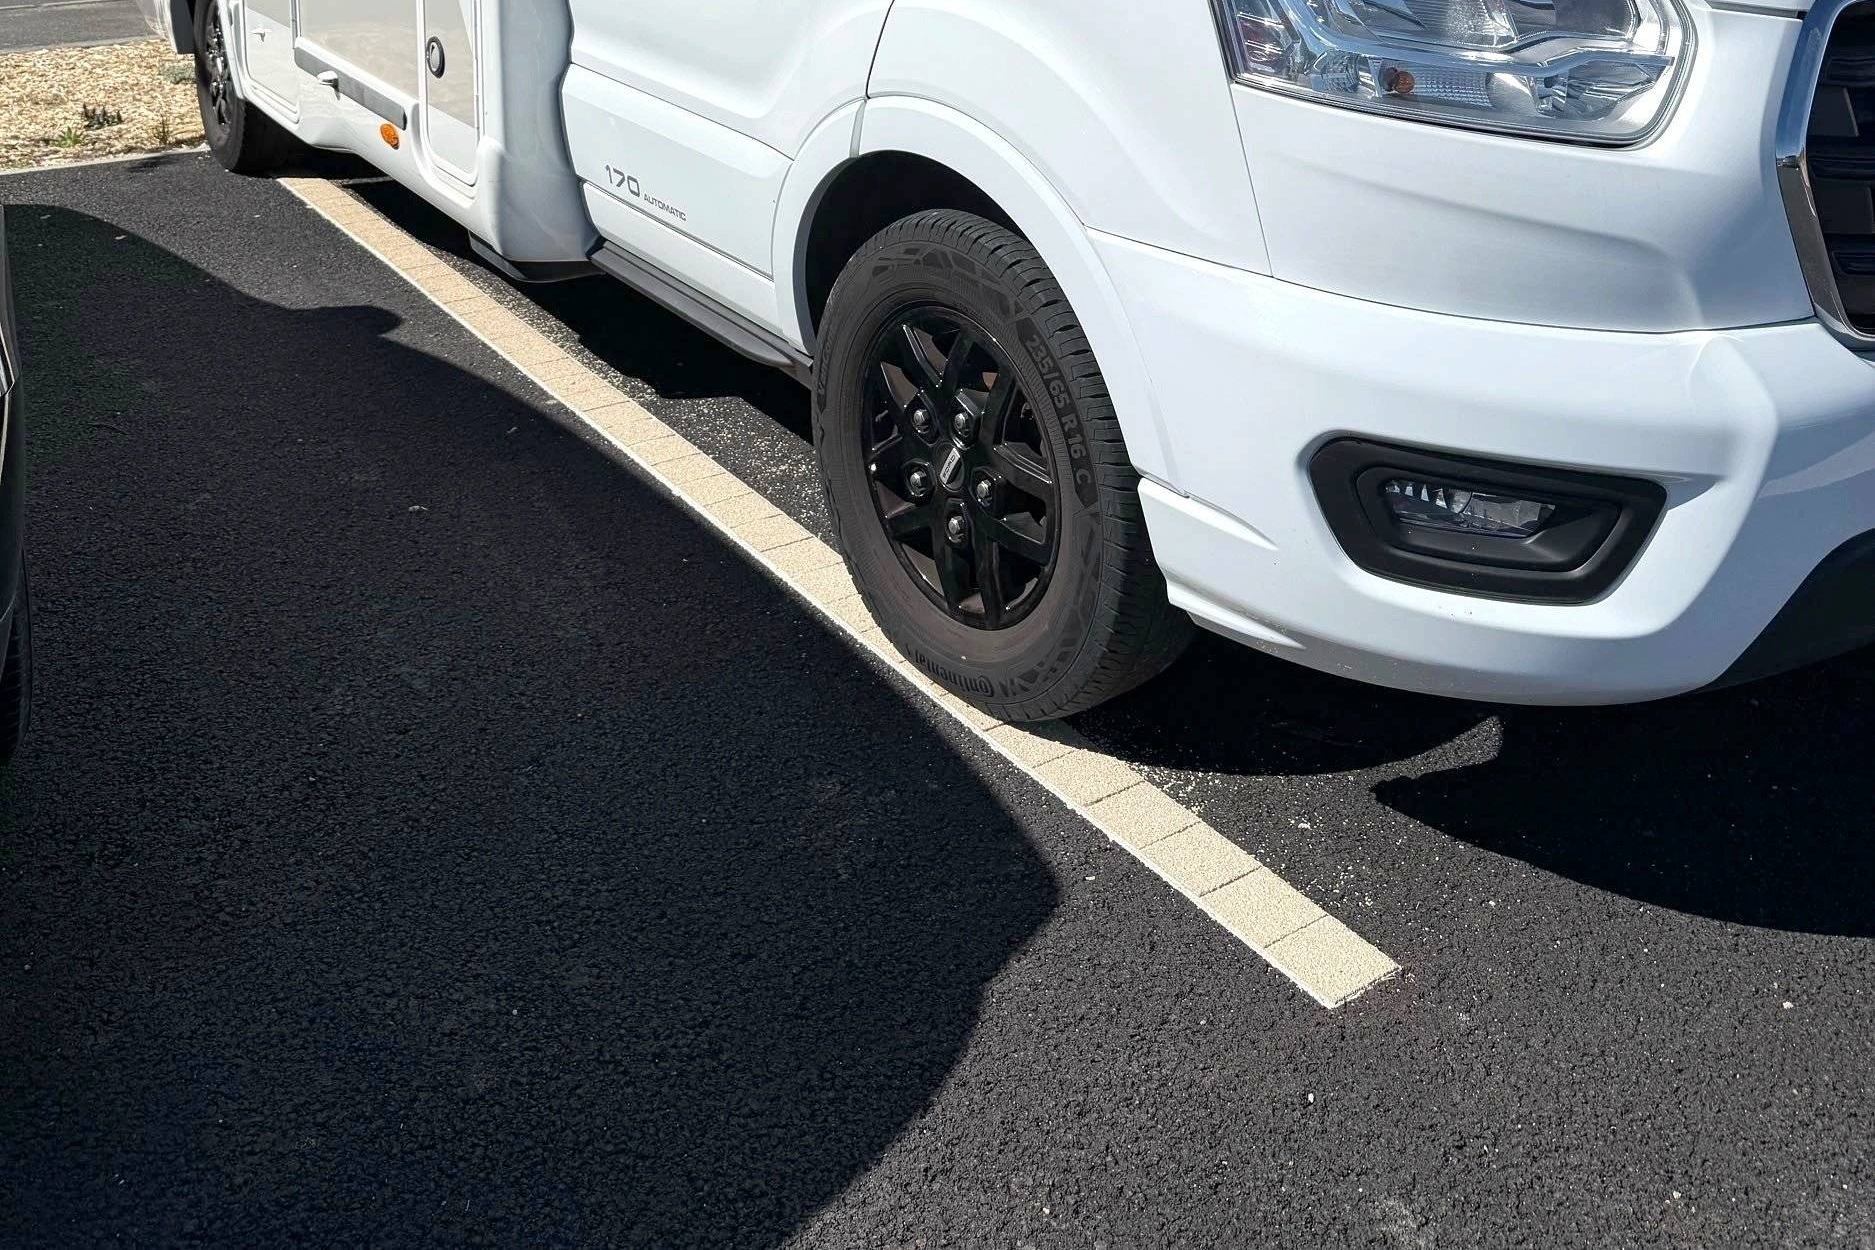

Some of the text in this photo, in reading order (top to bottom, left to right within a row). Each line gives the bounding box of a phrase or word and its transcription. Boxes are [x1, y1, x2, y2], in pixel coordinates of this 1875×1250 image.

[605, 164, 687, 222] 170 AUTOMATIC
[1025, 334, 1071, 410] 235/65
